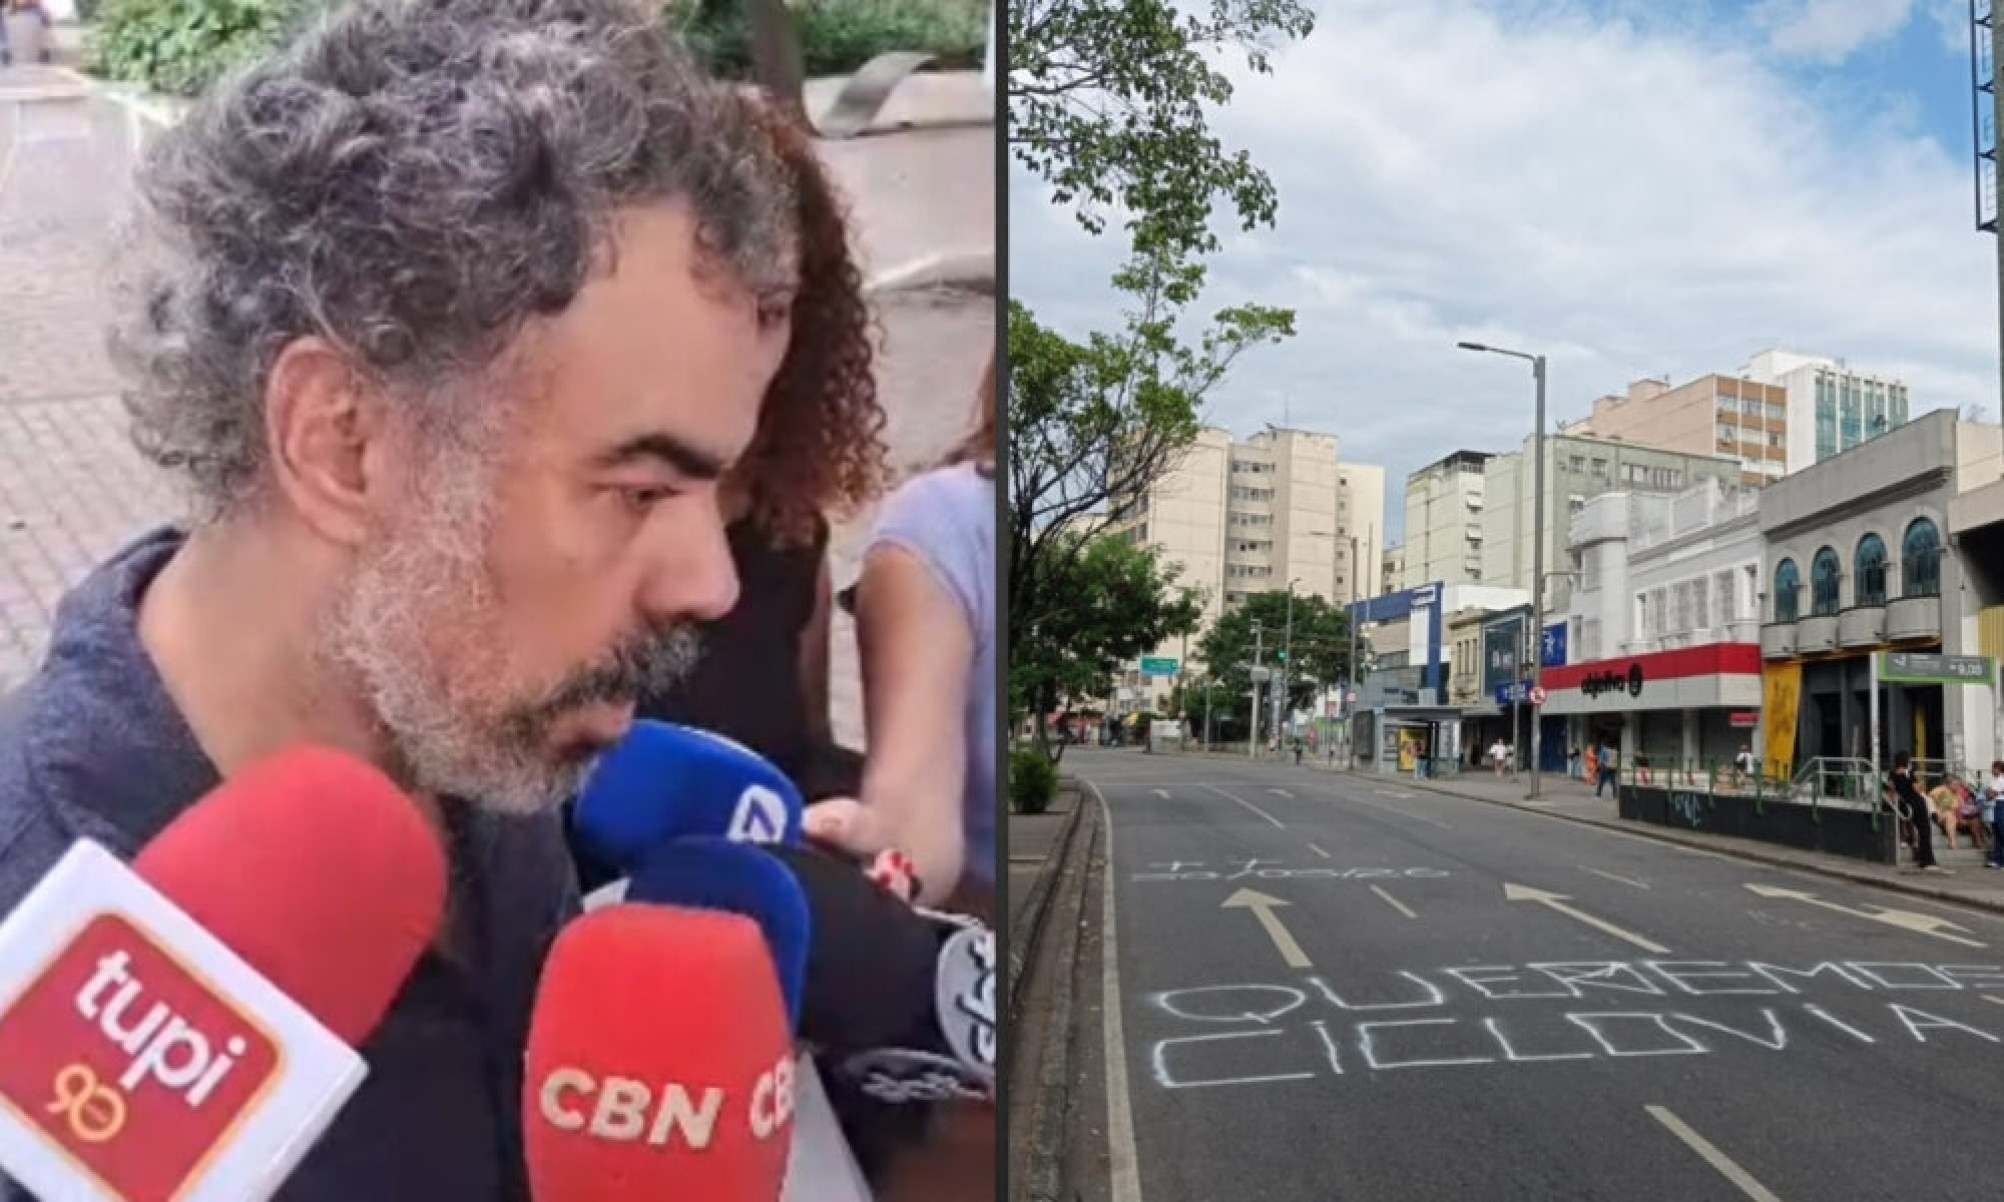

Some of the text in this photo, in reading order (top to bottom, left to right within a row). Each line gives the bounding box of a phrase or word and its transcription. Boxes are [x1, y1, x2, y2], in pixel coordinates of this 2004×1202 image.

[74, 949, 248, 1107] tupi
[1148, 960, 2004, 1024] QUEREMOS
[1152, 1002, 2000, 1089] CICLOVIA
[46, 1063, 127, 1143] 90
[540, 1067, 724, 1149] CBN
